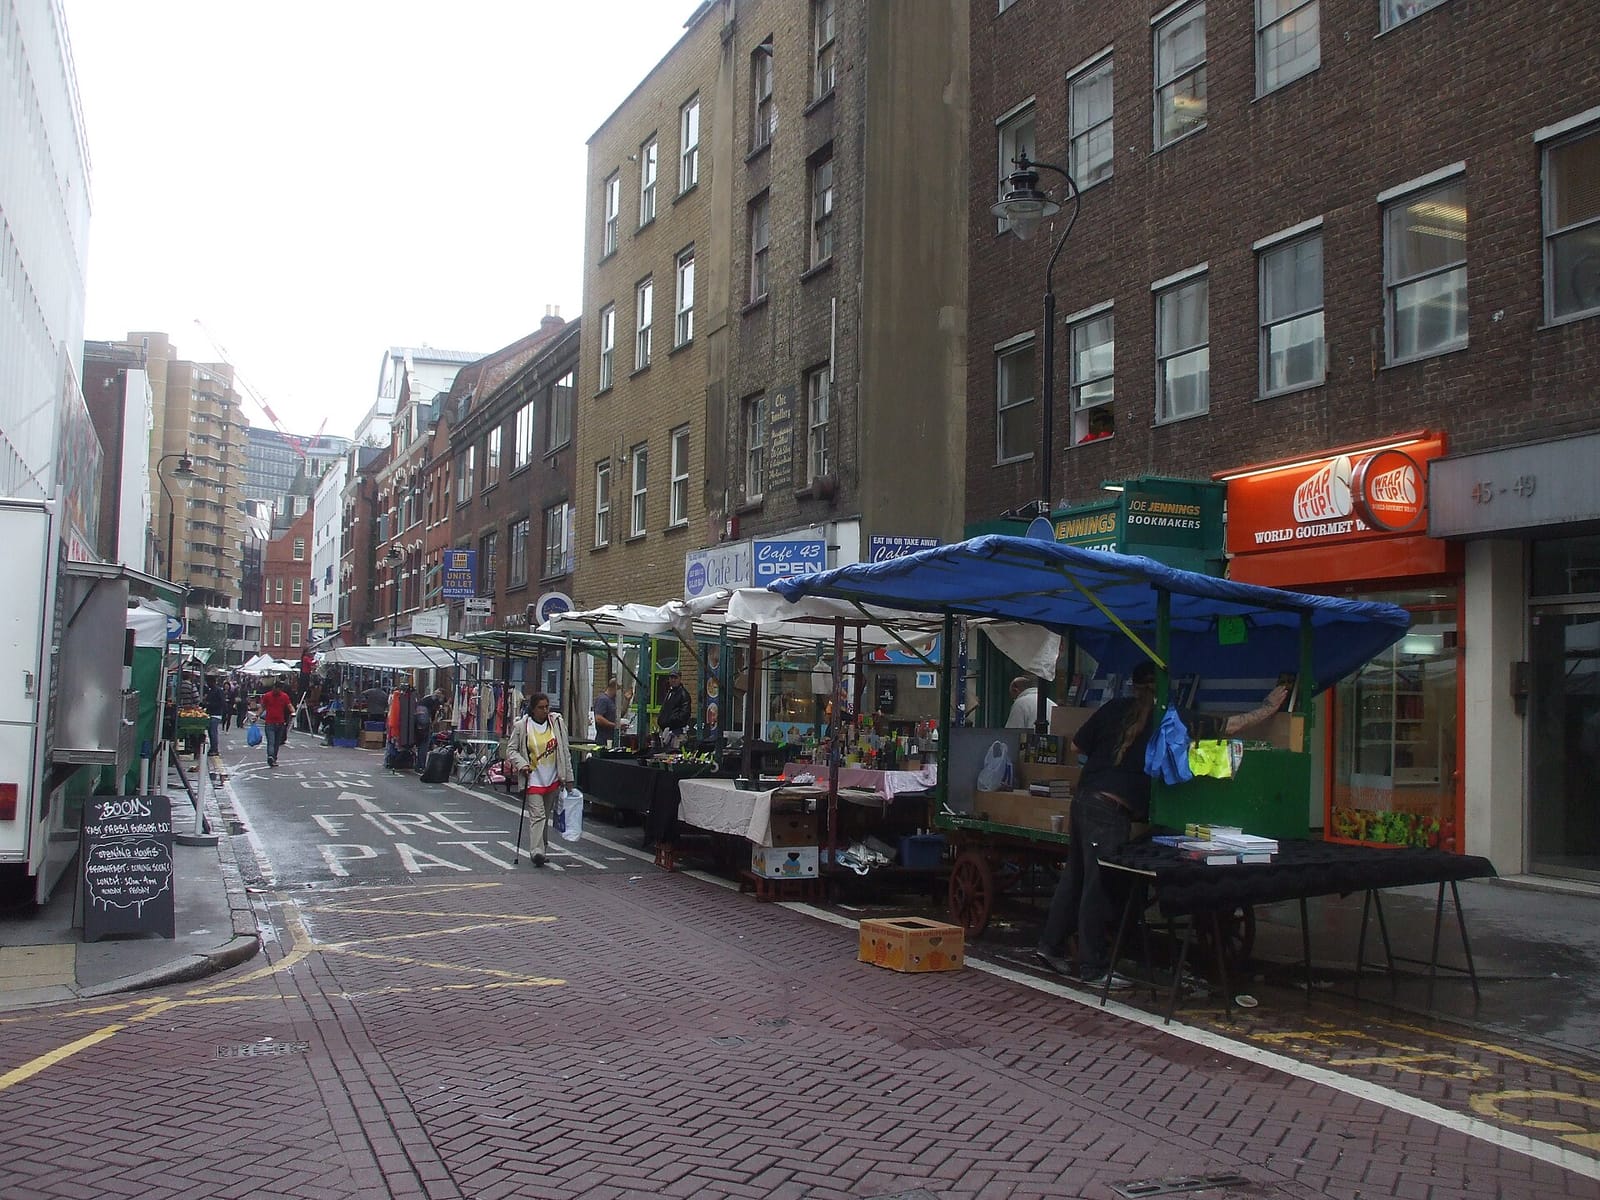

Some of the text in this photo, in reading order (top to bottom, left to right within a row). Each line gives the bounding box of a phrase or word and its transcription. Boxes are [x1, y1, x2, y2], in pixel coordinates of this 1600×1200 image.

[1298, 468, 1330, 502] WRAP
[1375, 470, 1401, 488] WRAP
[1375, 480, 1405, 501] IT UP!
[1471, 480, 1493, 504] 45
[1512, 475, 1536, 498] 49
[1128, 500, 1201, 516] JOE JENNINGS
[1298, 485, 1335, 519] IT UP!
[1127, 515, 1201, 529] BOOKMAKERS
[1255, 528, 1293, 544] WORLD
[1295, 520, 1353, 539] GOURMET
[873, 537, 884, 545] EAT
[886, 537, 893, 545] IN
[904, 538, 920, 546] TAKE
[920, 539, 938, 547] AWAY
[799, 545, 821, 558] 43
[447, 572, 472, 580] UNITS
[706, 556, 731, 588] Café
[758, 562, 822, 575] OPEN
[446, 580, 473, 588] TO LET
[104, 824, 130, 834] FRESH
[311, 811, 511, 837] FIRE
[316, 840, 609, 877] PATH
